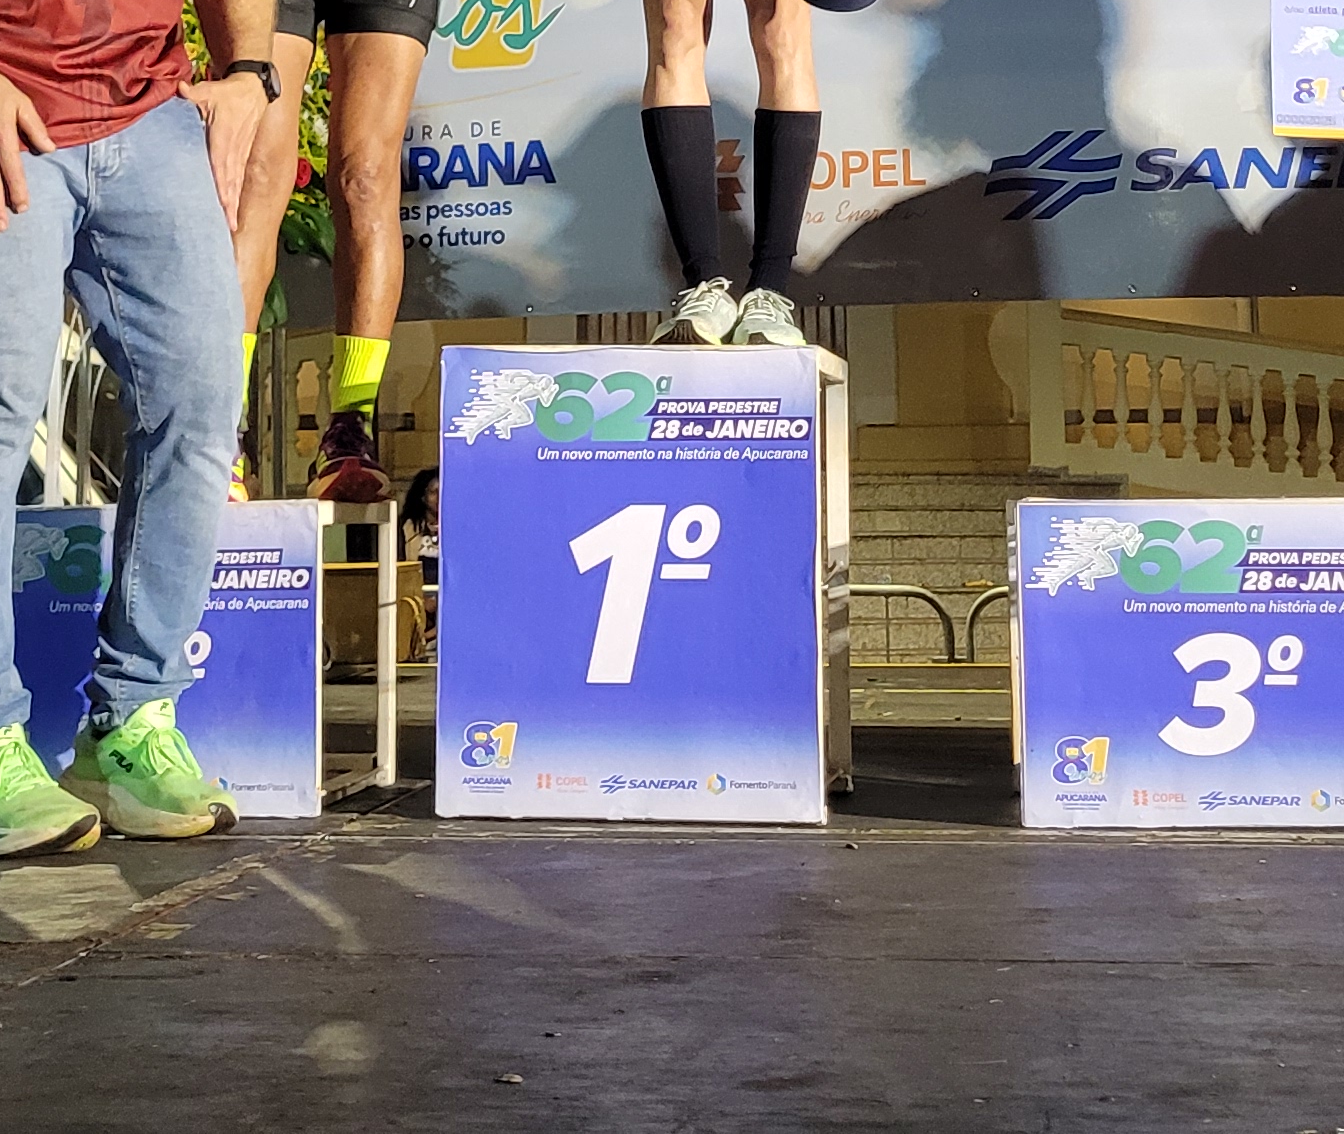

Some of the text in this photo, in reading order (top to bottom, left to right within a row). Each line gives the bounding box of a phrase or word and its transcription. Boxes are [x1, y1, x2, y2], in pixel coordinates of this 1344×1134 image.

[1308, 6, 1337, 15] atleta
[1293, 78, 1328, 104] 81
[403, 121, 501, 141] URA DE
[402, 140, 556, 192] RANA
[810, 149, 926, 190] OPEL
[427, 201, 512, 225] pessoas
[419, 234, 432, 248] o
[438, 227, 505, 247] futuro
[657, 401, 778, 414] PROVA PEDESTRE
[651, 419, 809, 439] 28 de JANEIRO
[537, 447, 809, 462] Um novo momento na história de Apucarana
[214, 551, 280, 564] PEDESTRE
[1249, 552, 1300, 565] PROVA
[1242, 574, 1272, 591] 28
[1275, 574, 1297, 589] de
[568, 504, 721, 684] 1º
[49, 602, 72, 613] Um
[228, 597, 309, 612] de Apucarana
[1123, 600, 1147, 613] Um
[1149, 602, 1182, 614] novo
[1184, 601, 1247, 614] momento
[1250, 602, 1266, 614] na
[1268, 599, 1317, 614] história
[1319, 600, 1336, 614] de
[1158, 632, 1304, 757] 3º
[460, 721, 518, 768] 81
[108, 749, 134, 773] FILA
[1051, 735, 1110, 785] 81
[462, 776, 512, 786] APUCARANA
[557, 776, 588, 787] COPEL
[627, 779, 698, 791] SANEPAR
[1055, 793, 1108, 803] APUCARANA
[1153, 791, 1187, 804] COPEL
[1227, 795, 1301, 807] SANEPAR
